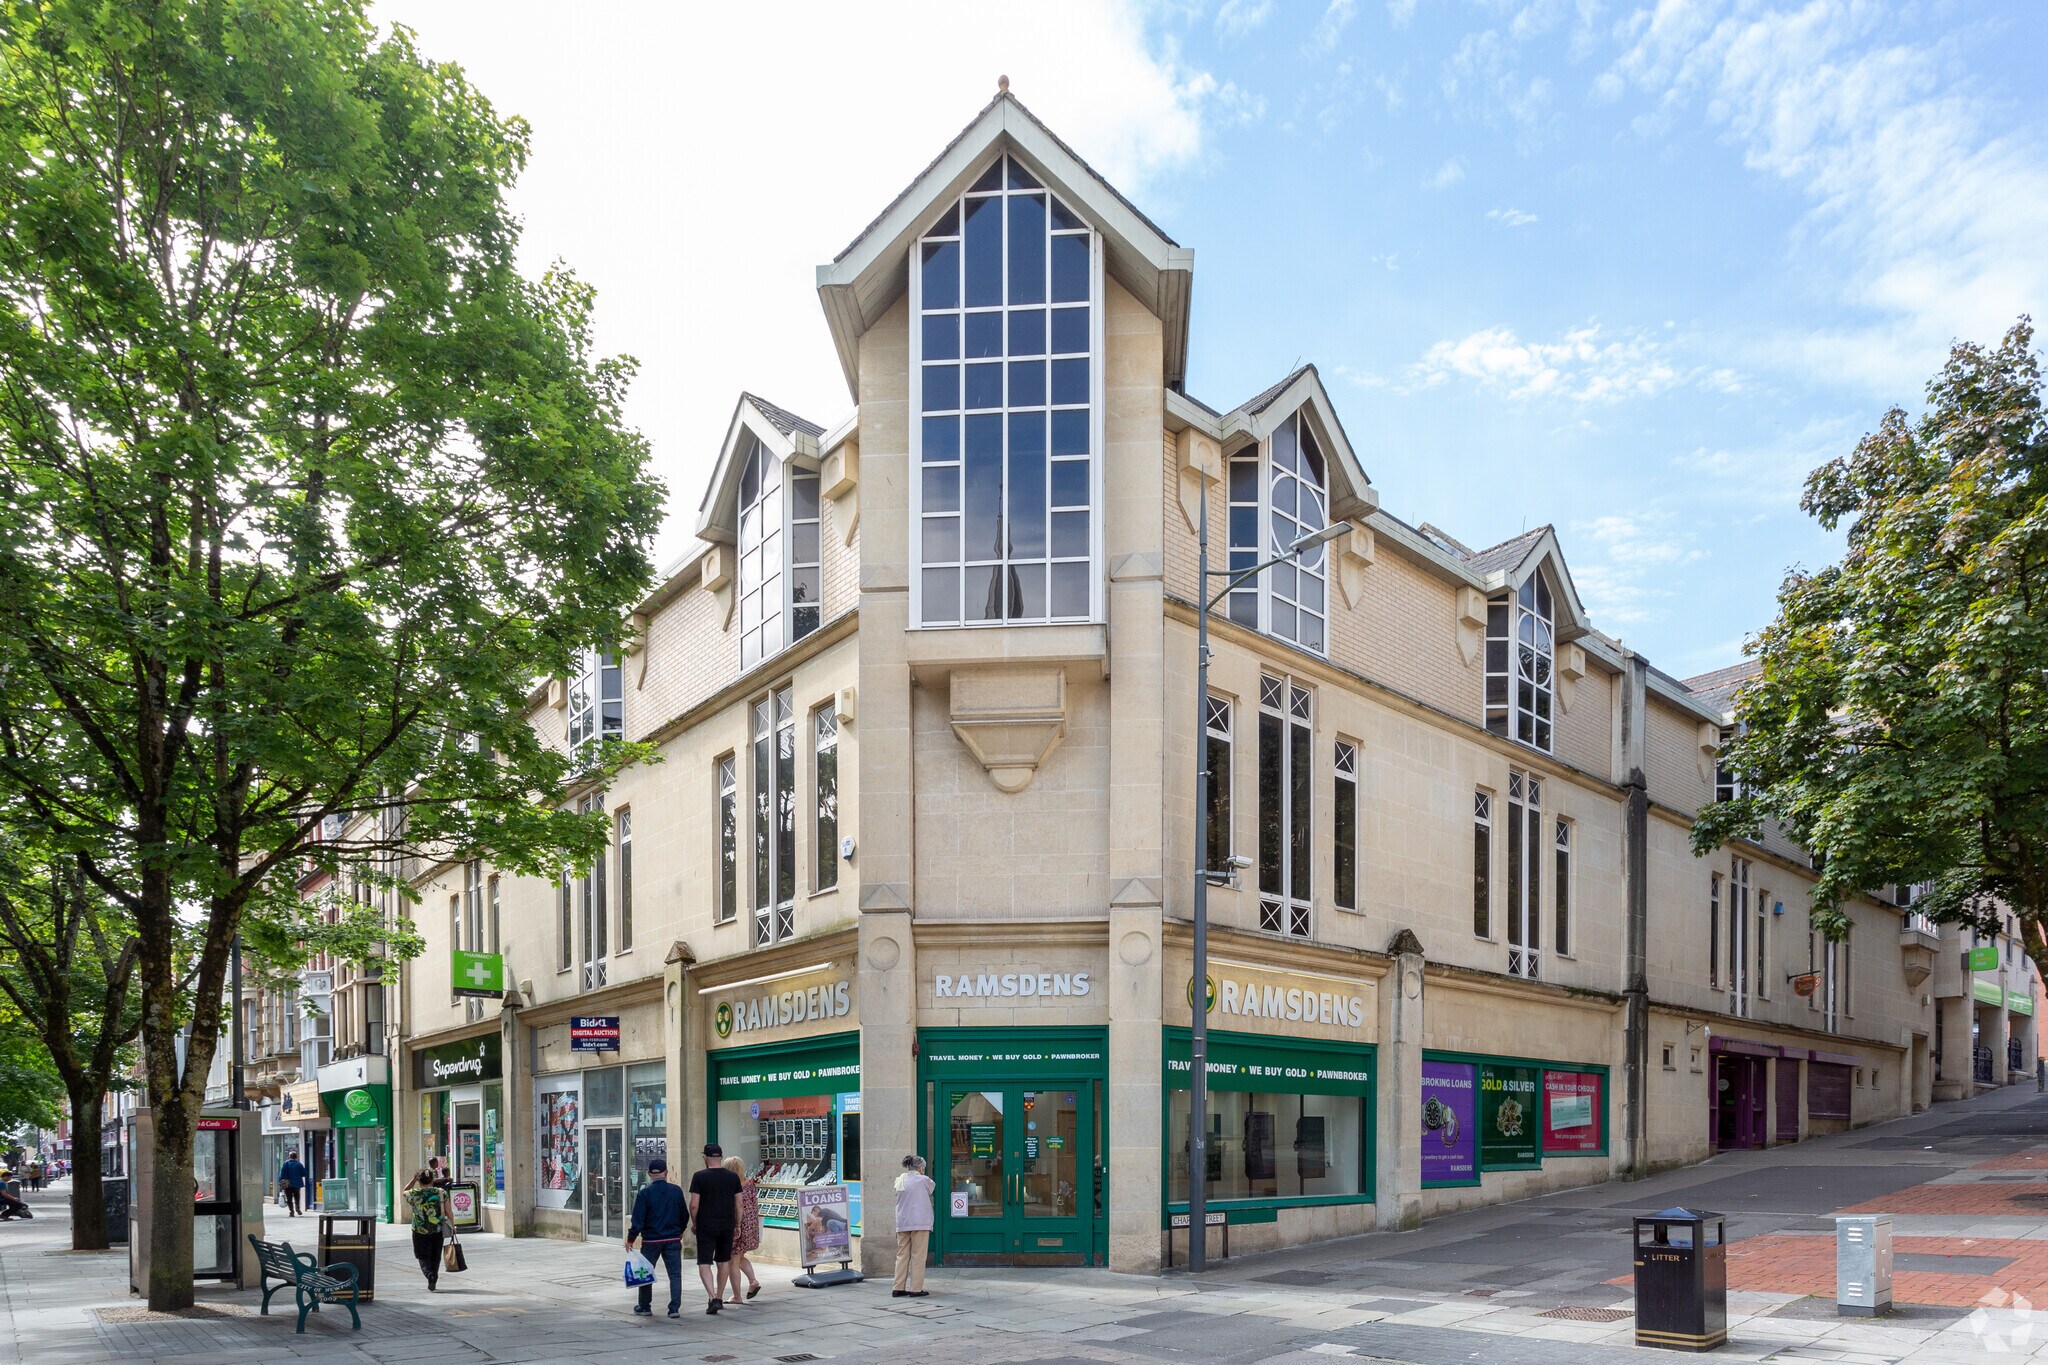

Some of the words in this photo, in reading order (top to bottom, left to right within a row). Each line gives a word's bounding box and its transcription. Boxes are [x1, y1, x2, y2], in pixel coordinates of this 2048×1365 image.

[463, 952, 494, 960] PHARMACY
[935, 973, 1090, 997] RAMSDENS
[733, 981, 850, 1032] RAMSDENS
[1221, 979, 1364, 1028] RAMSDENS
[433, 1056, 483, 1080] Superdrug
[1168, 1060, 1191, 1071] TRAV
[1205, 1063, 1237, 1074] MONEY
[1249, 1065, 1262, 1075] WE
[1265, 1066, 1282, 1076] BUY
[1285, 1067, 1307, 1078] GOLD
[1317, 1070, 1367, 1081] PAWNBROKER
[719, 1076, 740, 1085] TRAVEL
[741, 1074, 761, 1084] MONEY
[768, 1073, 777, 1082] WE
[778, 1072, 791, 1081] BUY
[793, 1070, 810, 1079] GOLD
[818, 1065, 860, 1077] PAWNBROKE
[1451, 1079, 1472, 1089] LOANS
[1503, 1080, 1509, 1091] &
[1509, 1080, 1535, 1092] SILVER
[1546, 1083, 1558, 1091] CASH
[1565, 1084, 1577, 1092] YOUR
[1578, 1085, 1596, 1093] CHEQUE
[349, 1095, 368, 1106] VPZ
[1450, 1164, 1473, 1172] RAMSDENS
[805, 1193, 842, 1205] LOANS
[1206, 1214, 1223, 1223] TREET
[1652, 1254, 1680, 1262] LITTER
[298, 1283, 312, 1291] CITY
